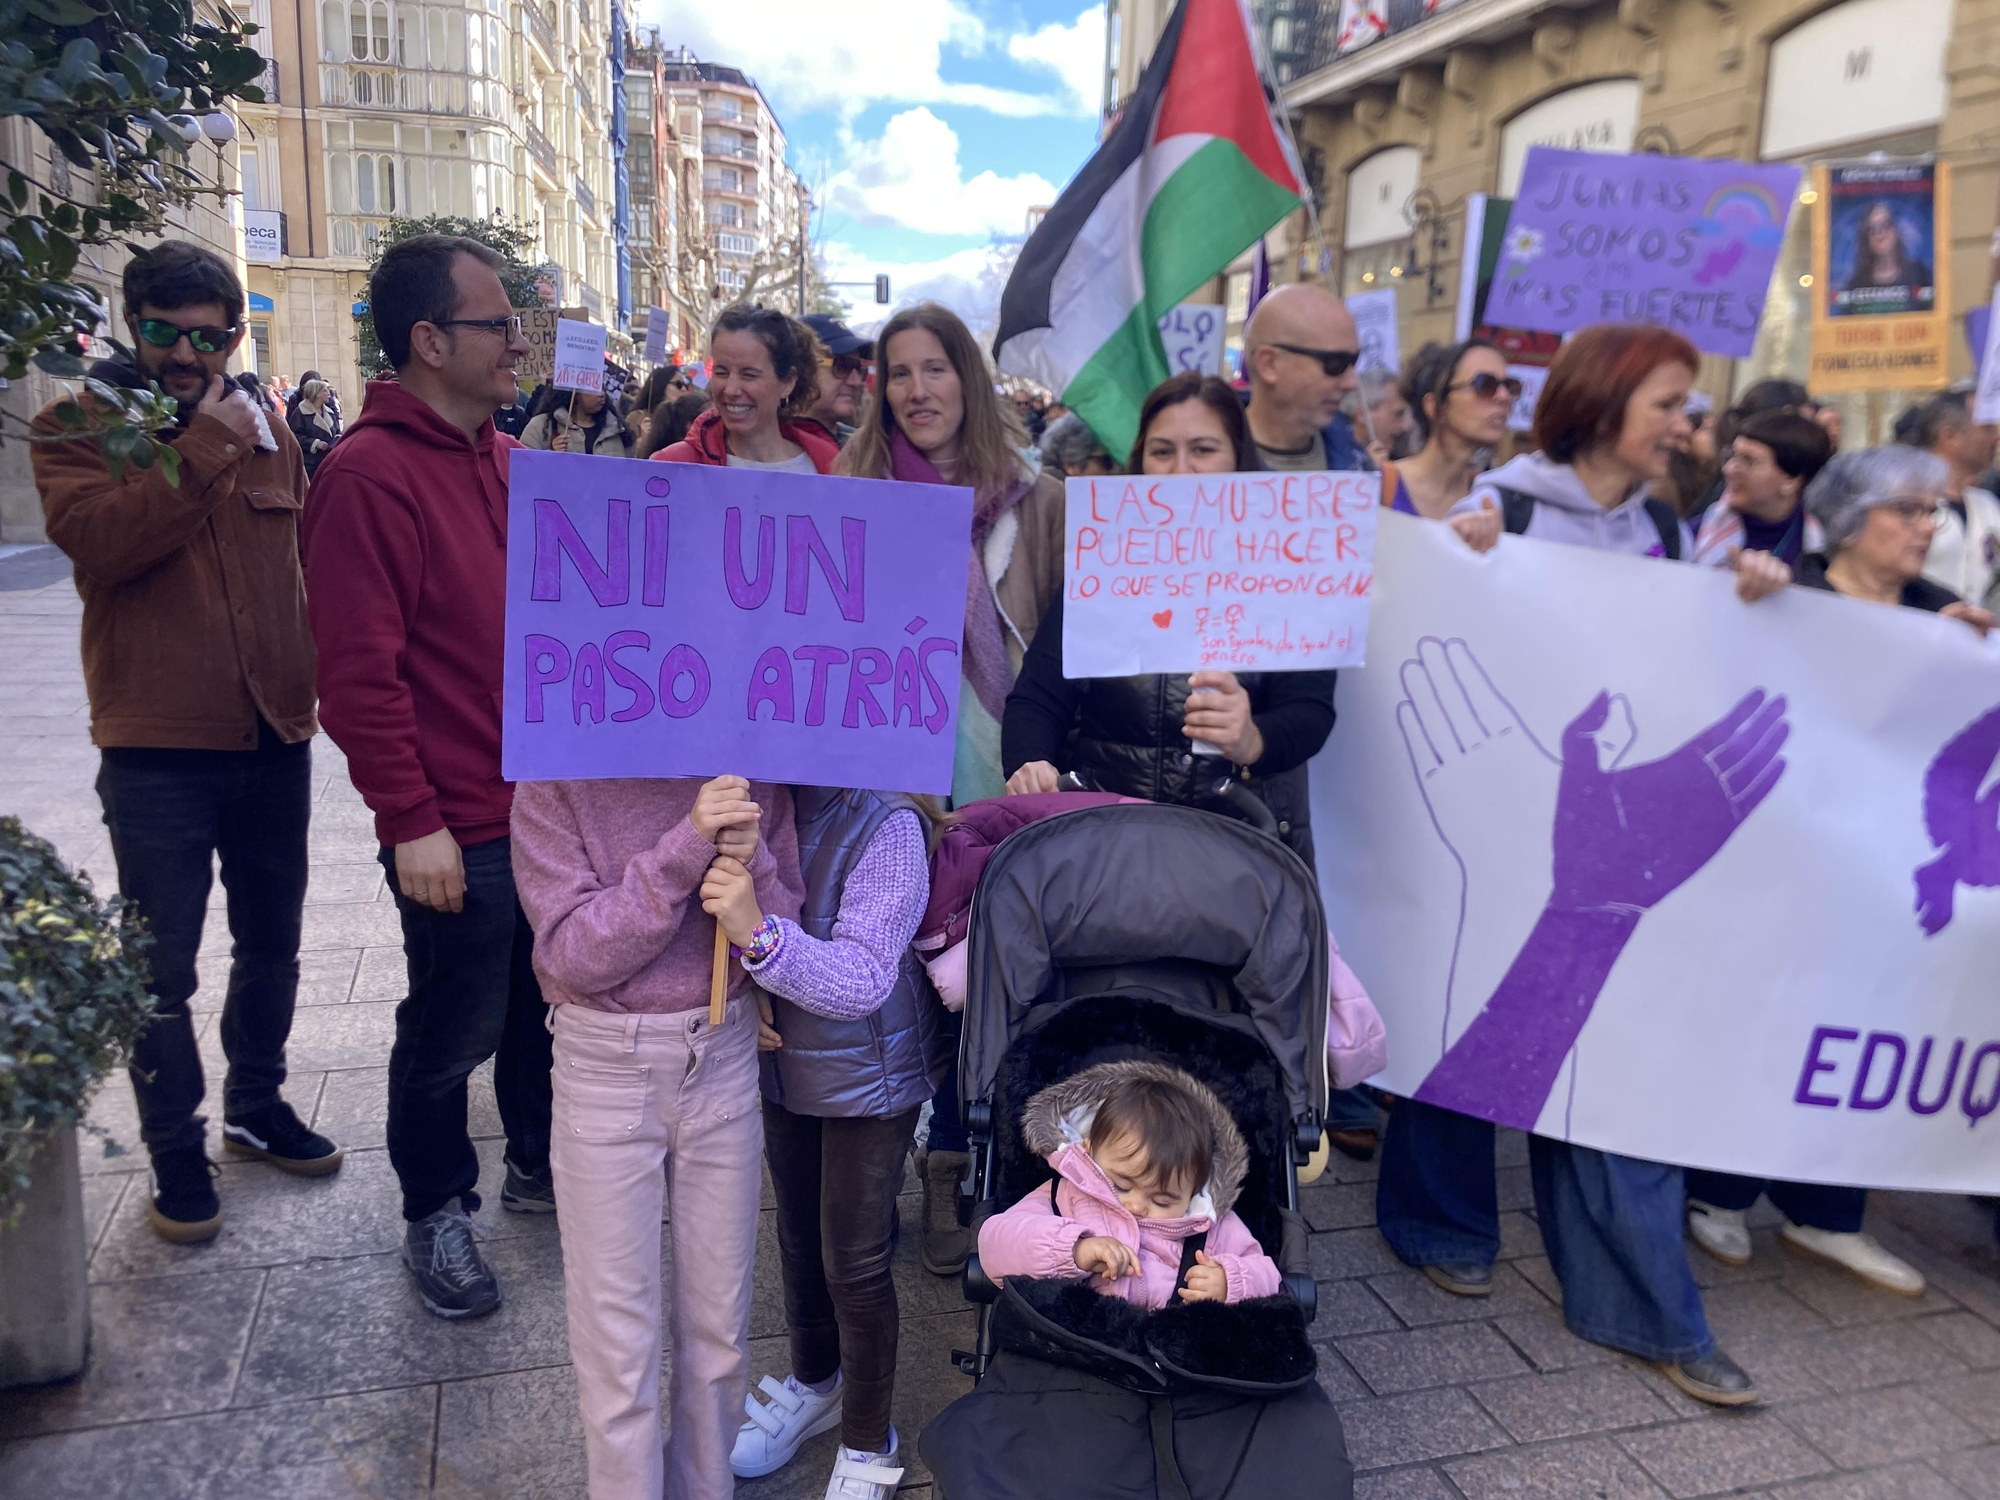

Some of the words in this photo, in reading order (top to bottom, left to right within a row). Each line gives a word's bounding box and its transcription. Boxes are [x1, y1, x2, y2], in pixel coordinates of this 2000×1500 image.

[1553, 220, 1700, 267] SOMOS
[1600, 286, 1763, 335] FUERTES
[1091, 479, 1174, 525] LAS
[1189, 474, 1373, 525] MUJERES
[723, 507, 867, 623] UN
[1076, 526, 1217, 571] PUEDEN
[1235, 523, 1360, 564] HACER
[1068, 574, 1100, 601] LO
[1110, 574, 1160, 597] QUE
[1163, 572, 1201, 597] SE
[1299, 629, 1334, 655] igual
[1337, 627, 1353, 650] el
[525, 630, 712, 726] PASO
[747, 616, 958, 735] ATRÁS
